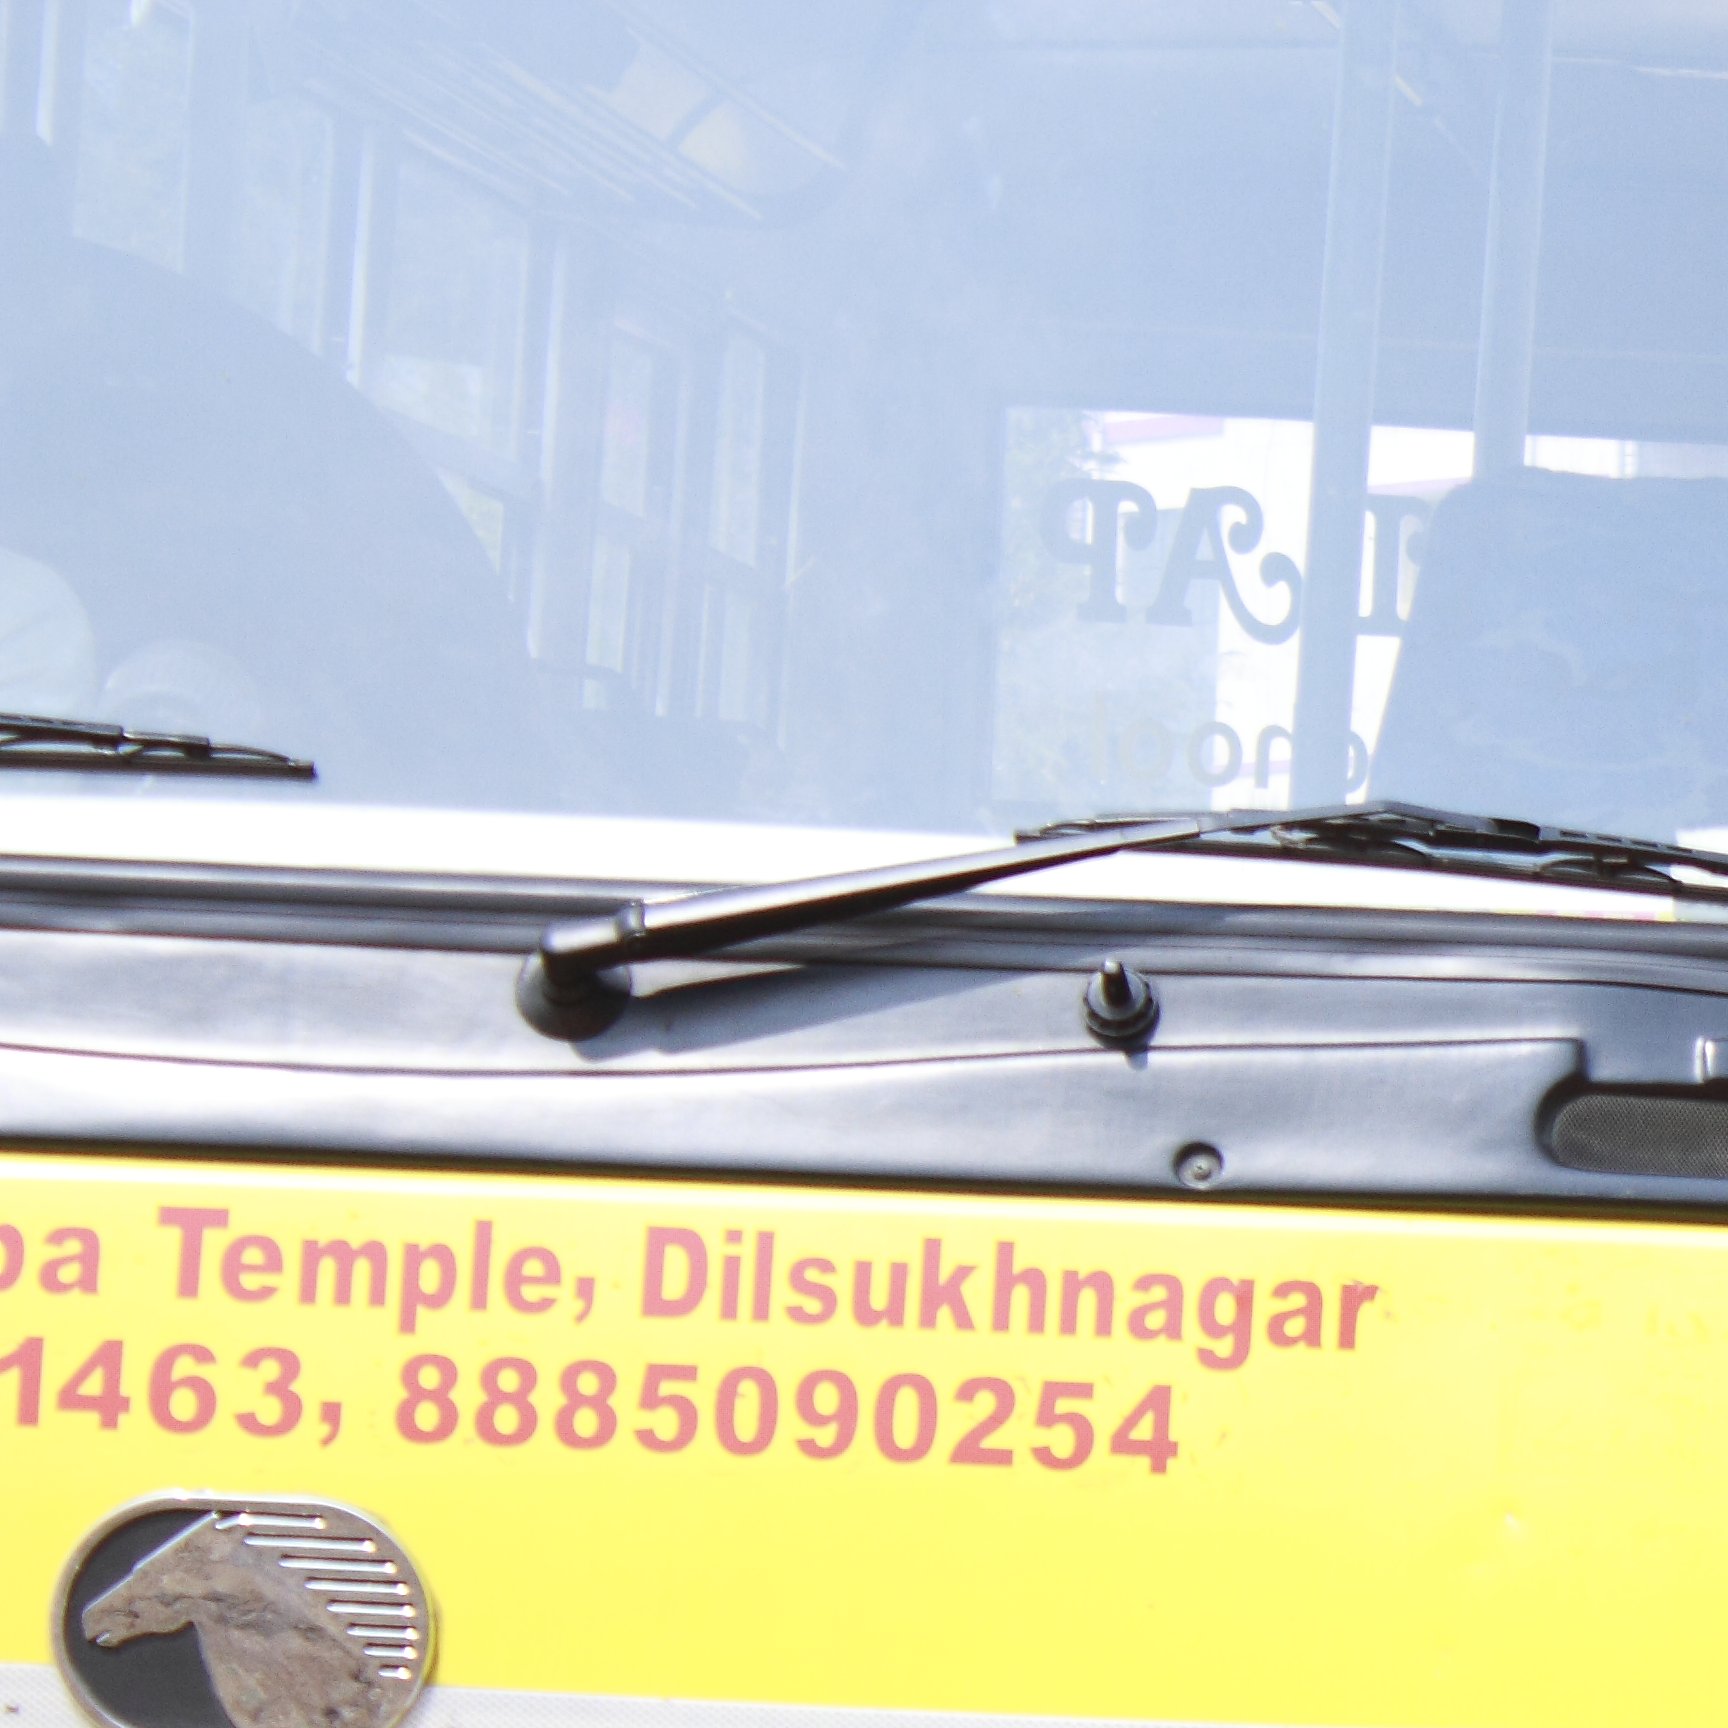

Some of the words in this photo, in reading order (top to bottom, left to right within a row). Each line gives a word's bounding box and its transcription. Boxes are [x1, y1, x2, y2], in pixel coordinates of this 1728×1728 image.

[157, 1205, 597, 1333] Temple,
[640, 1223, 1382, 1371] Dilsukhnagar
[0, 1336, 342, 1449] 1463,
[394, 1353, 1179, 1476] 8885090254
